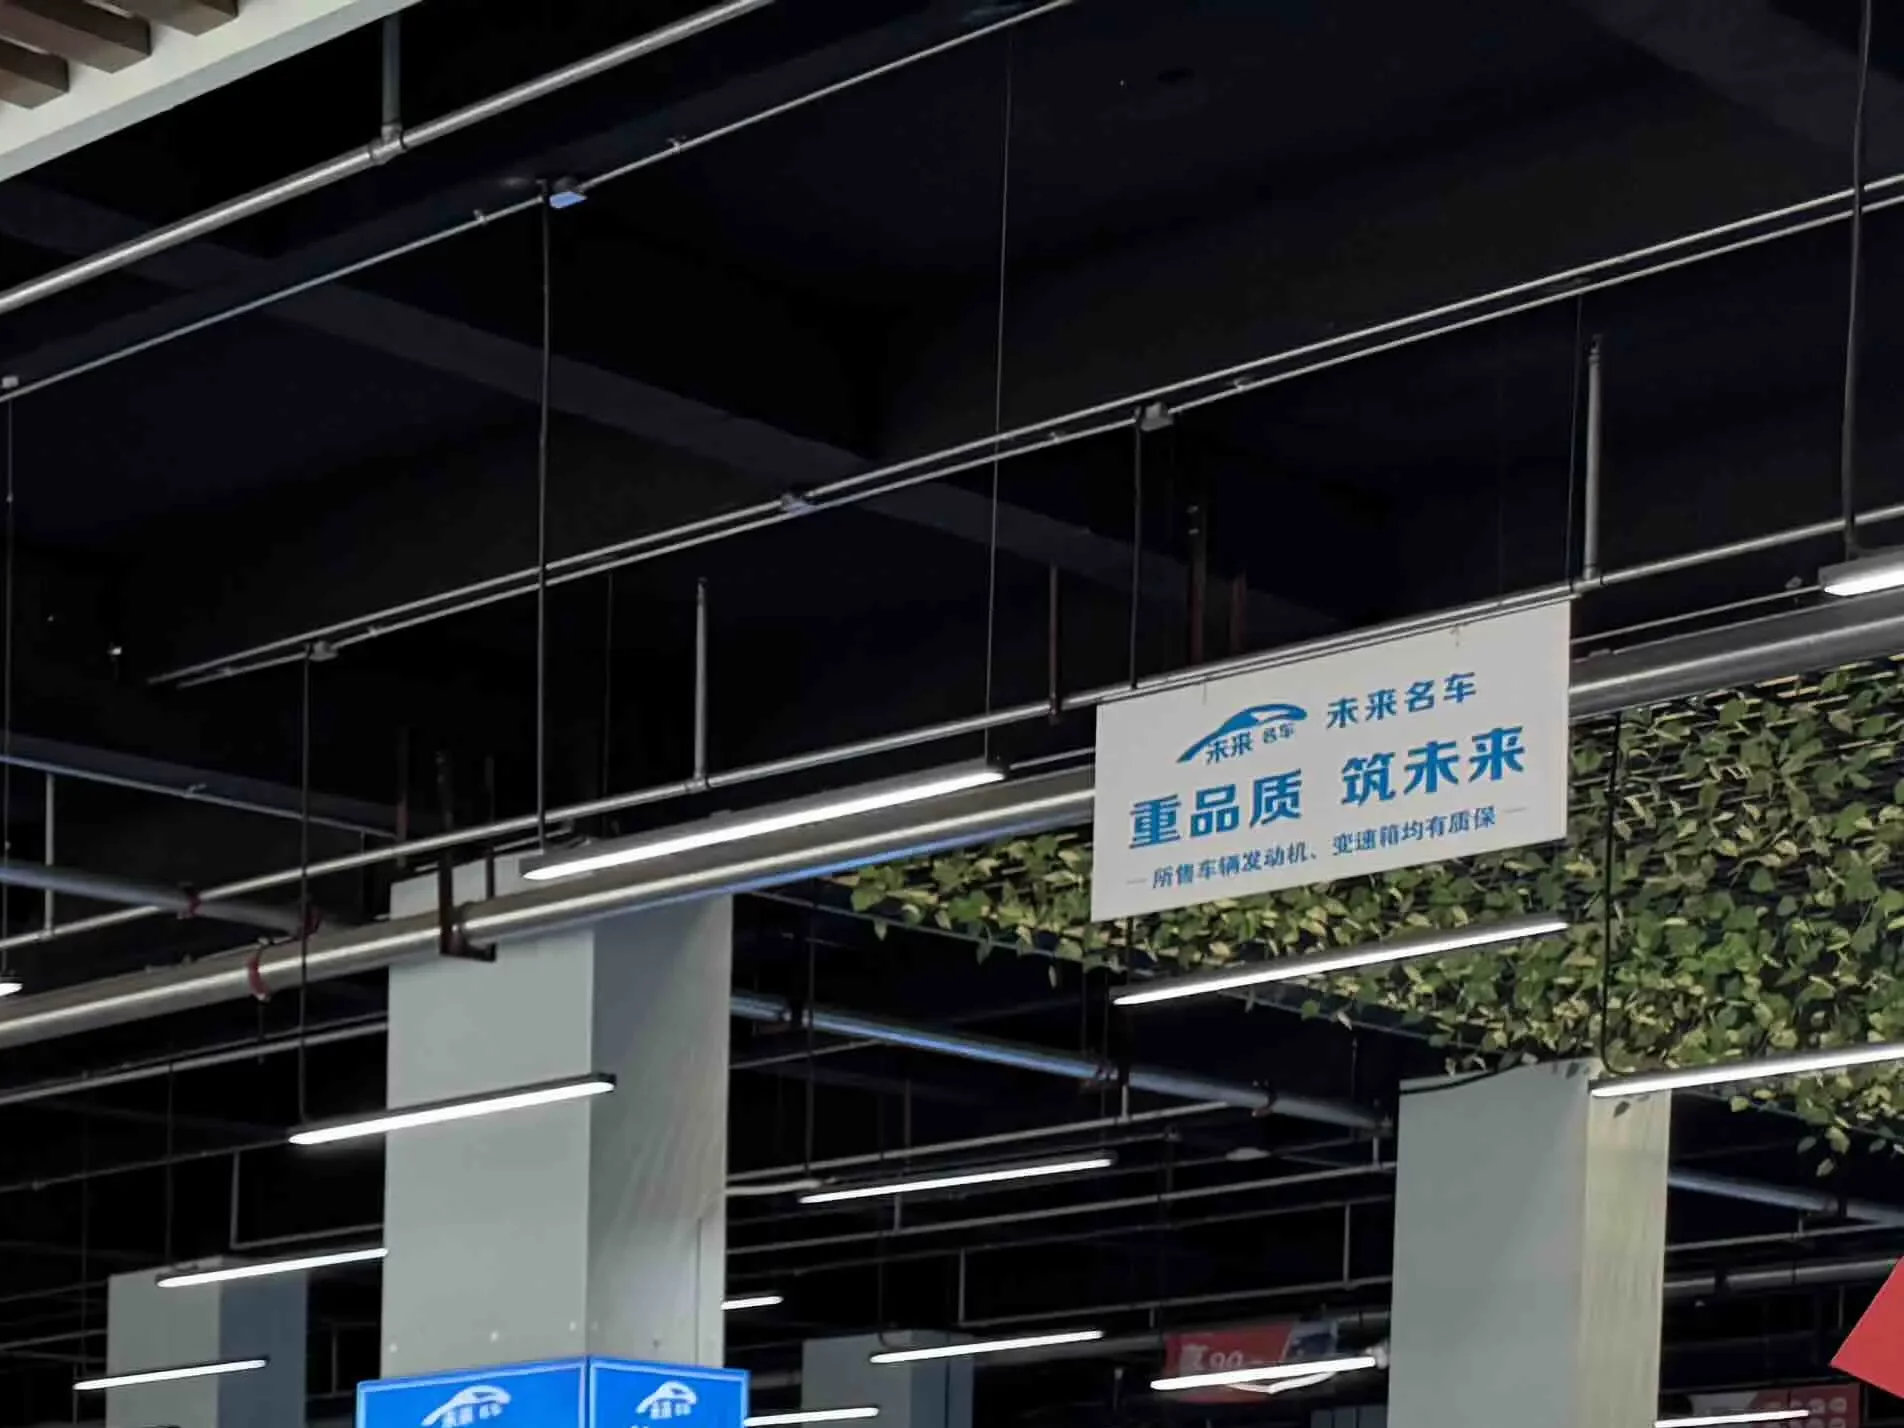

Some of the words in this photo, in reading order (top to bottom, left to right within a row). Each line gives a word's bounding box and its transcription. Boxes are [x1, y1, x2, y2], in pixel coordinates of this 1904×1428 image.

[1326, 671, 1477, 729] 未来名车
[1129, 768, 1303, 849] 重品质
[1341, 725, 1527, 807] 筑未来
